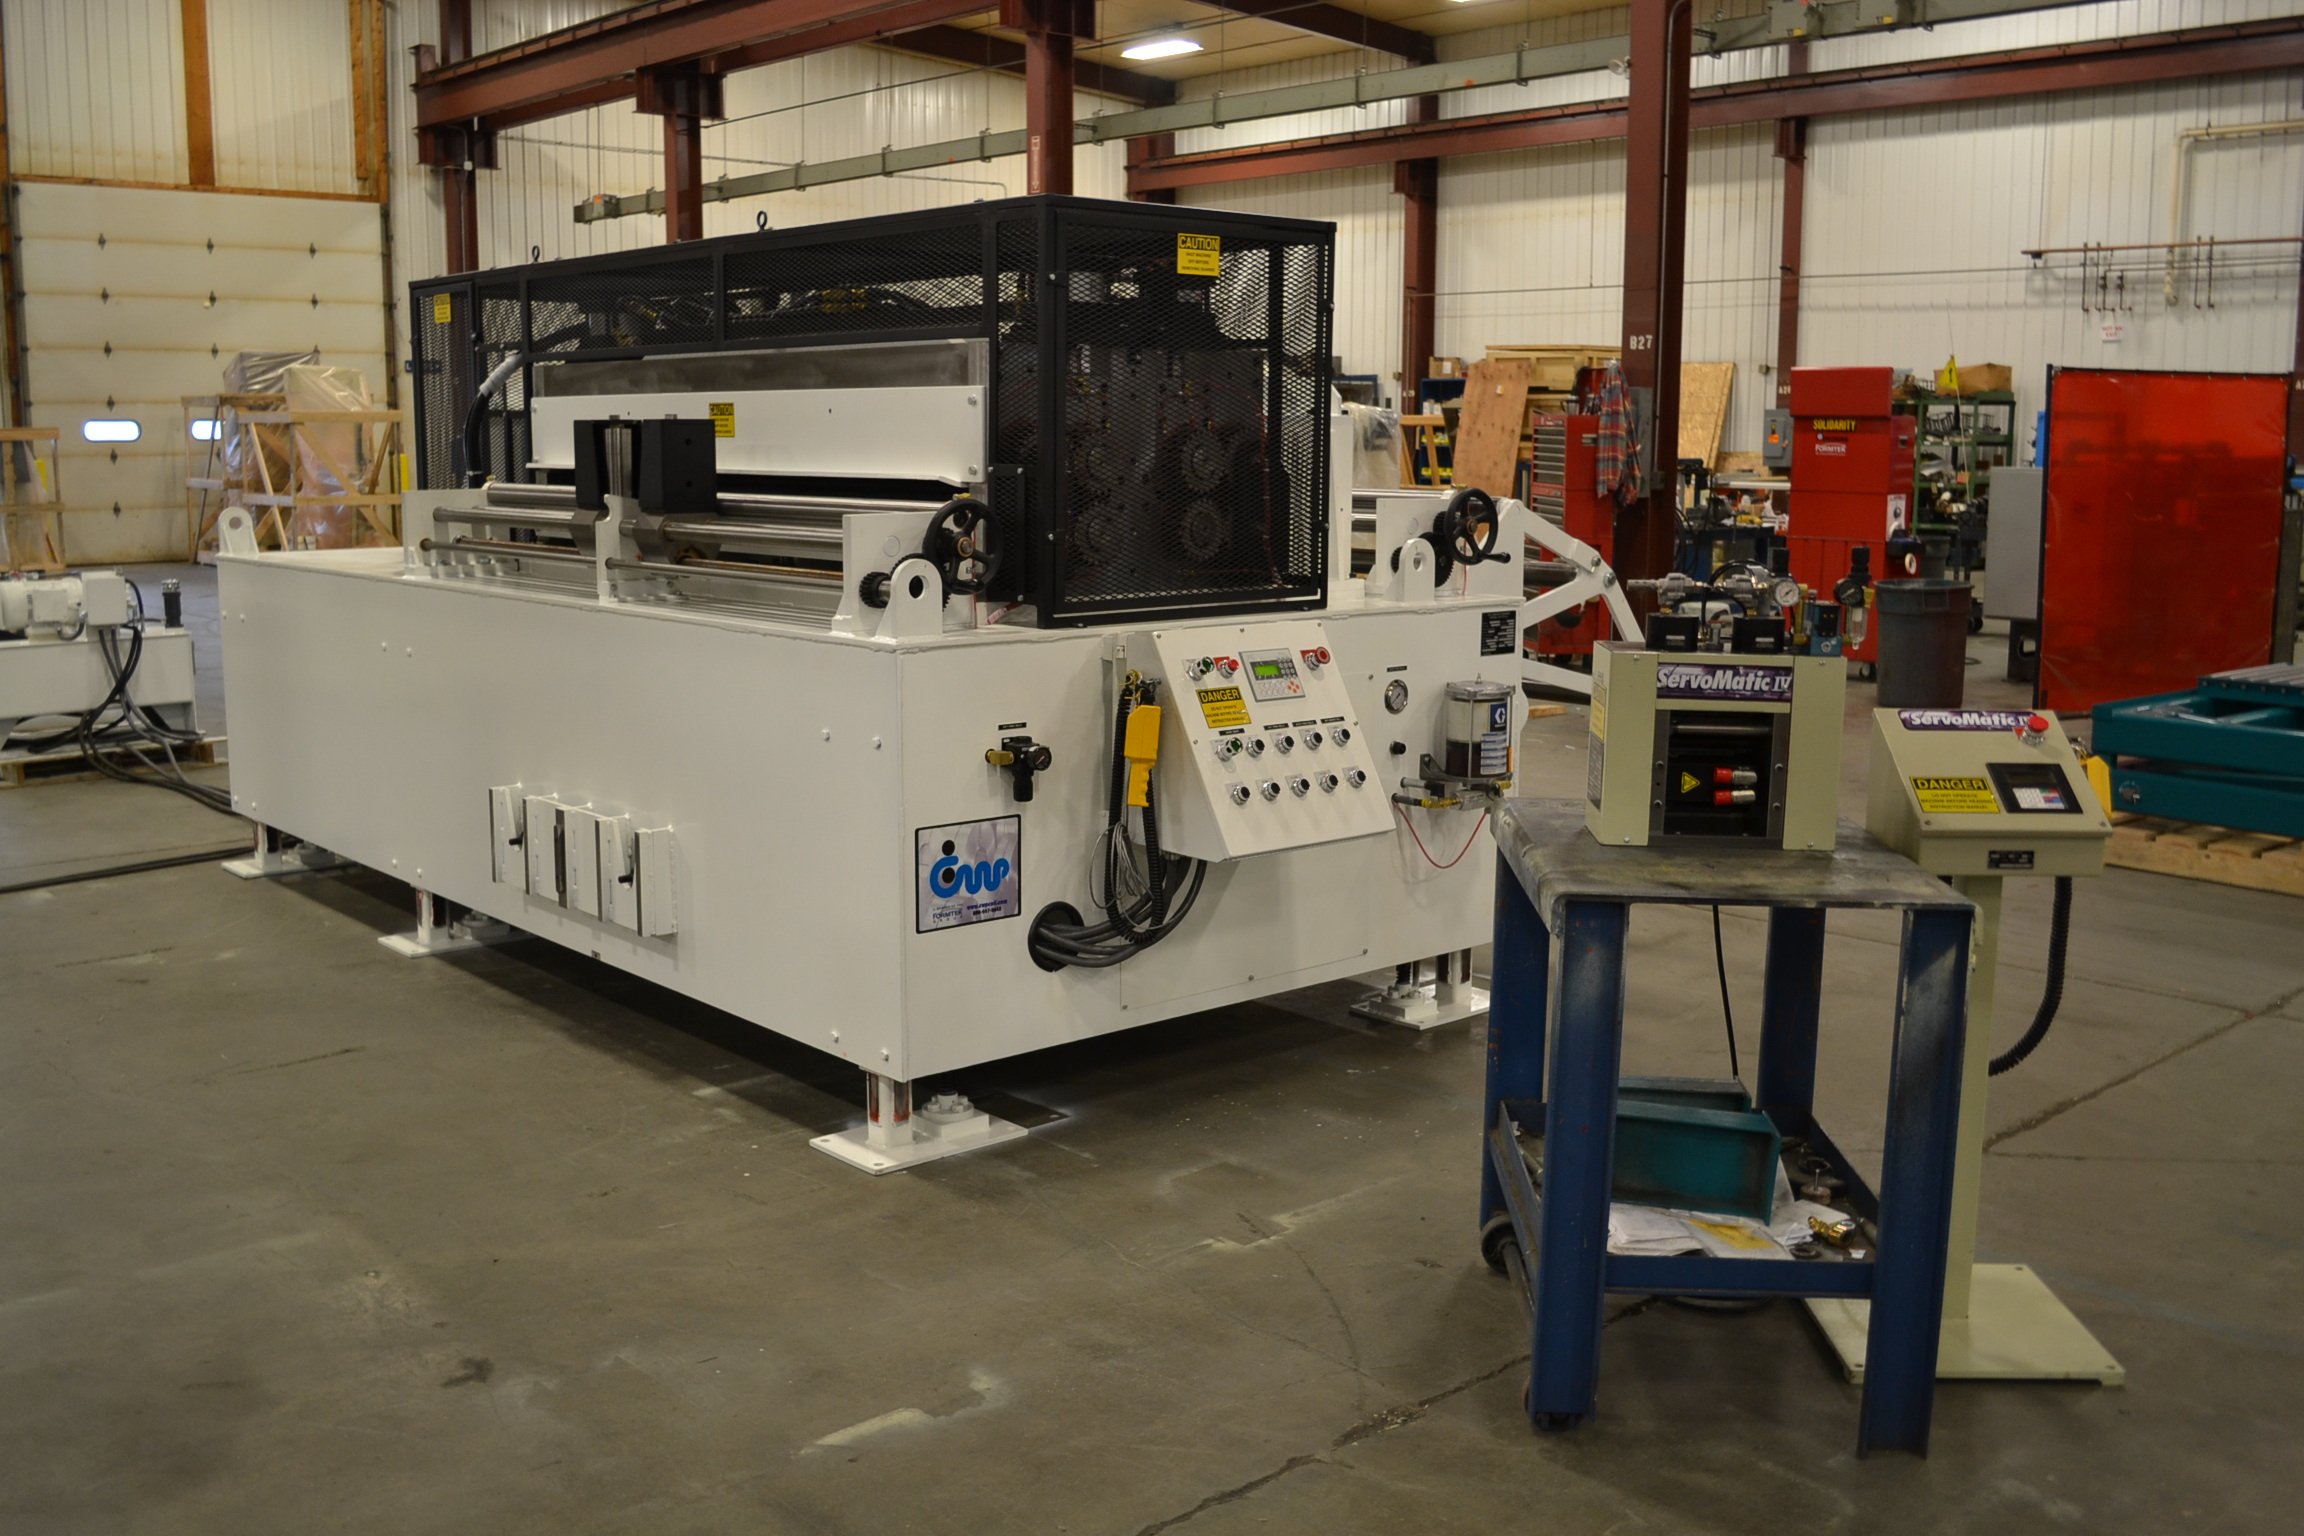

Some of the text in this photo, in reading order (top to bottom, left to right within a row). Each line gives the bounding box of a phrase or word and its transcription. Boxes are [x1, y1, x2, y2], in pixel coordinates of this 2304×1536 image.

[1180, 236, 1218, 250] CAUTION
[1630, 335, 1653, 350] B27
[1813, 419, 1856, 431] SOLIDARITY
[1657, 668, 1793, 692] ServoMatic IV
[1200, 689, 1239, 702] DANGER
[1911, 711, 2016, 726] ServoMatic
[1917, 779, 1985, 789] DANGER
